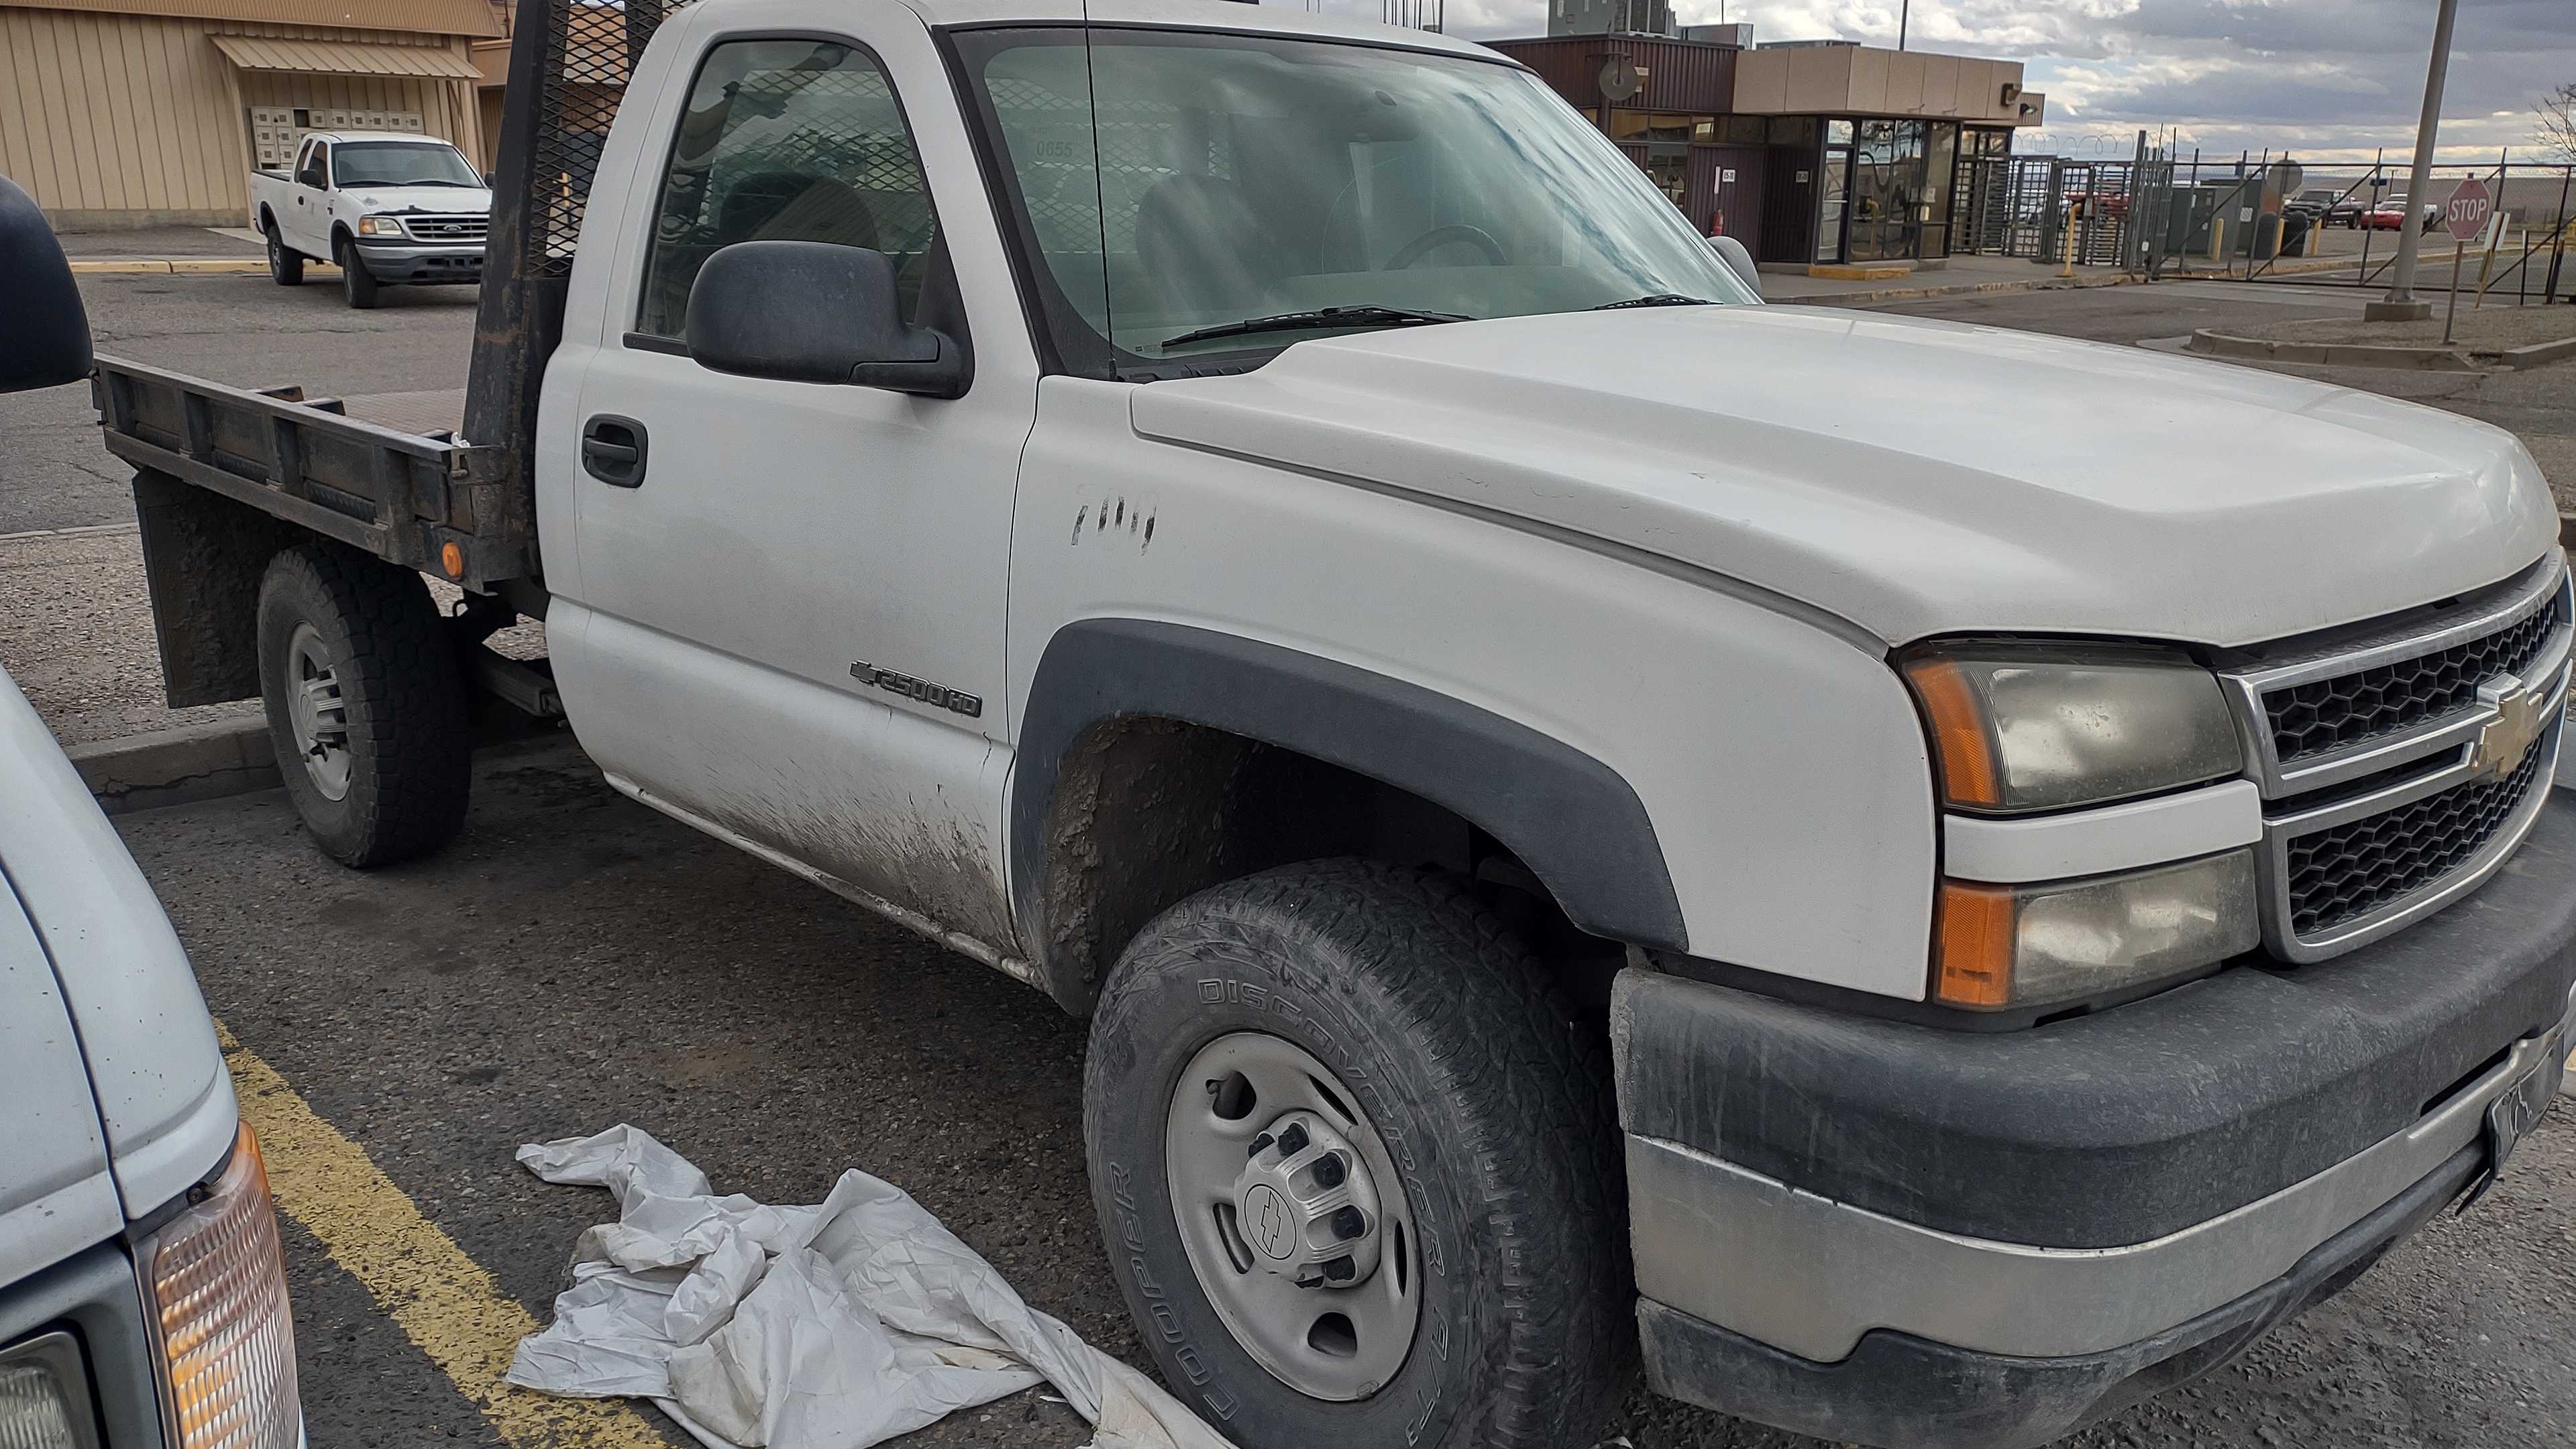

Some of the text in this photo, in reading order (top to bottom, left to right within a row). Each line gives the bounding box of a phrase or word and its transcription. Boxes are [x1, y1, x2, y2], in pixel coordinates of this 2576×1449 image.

[1037, 141, 1073, 157] 0655
[2450, 199, 2487, 221] STOP
[1197, 977, 1445, 1277] DISCOVERER
[1109, 1161, 1240, 1421] COOPER
